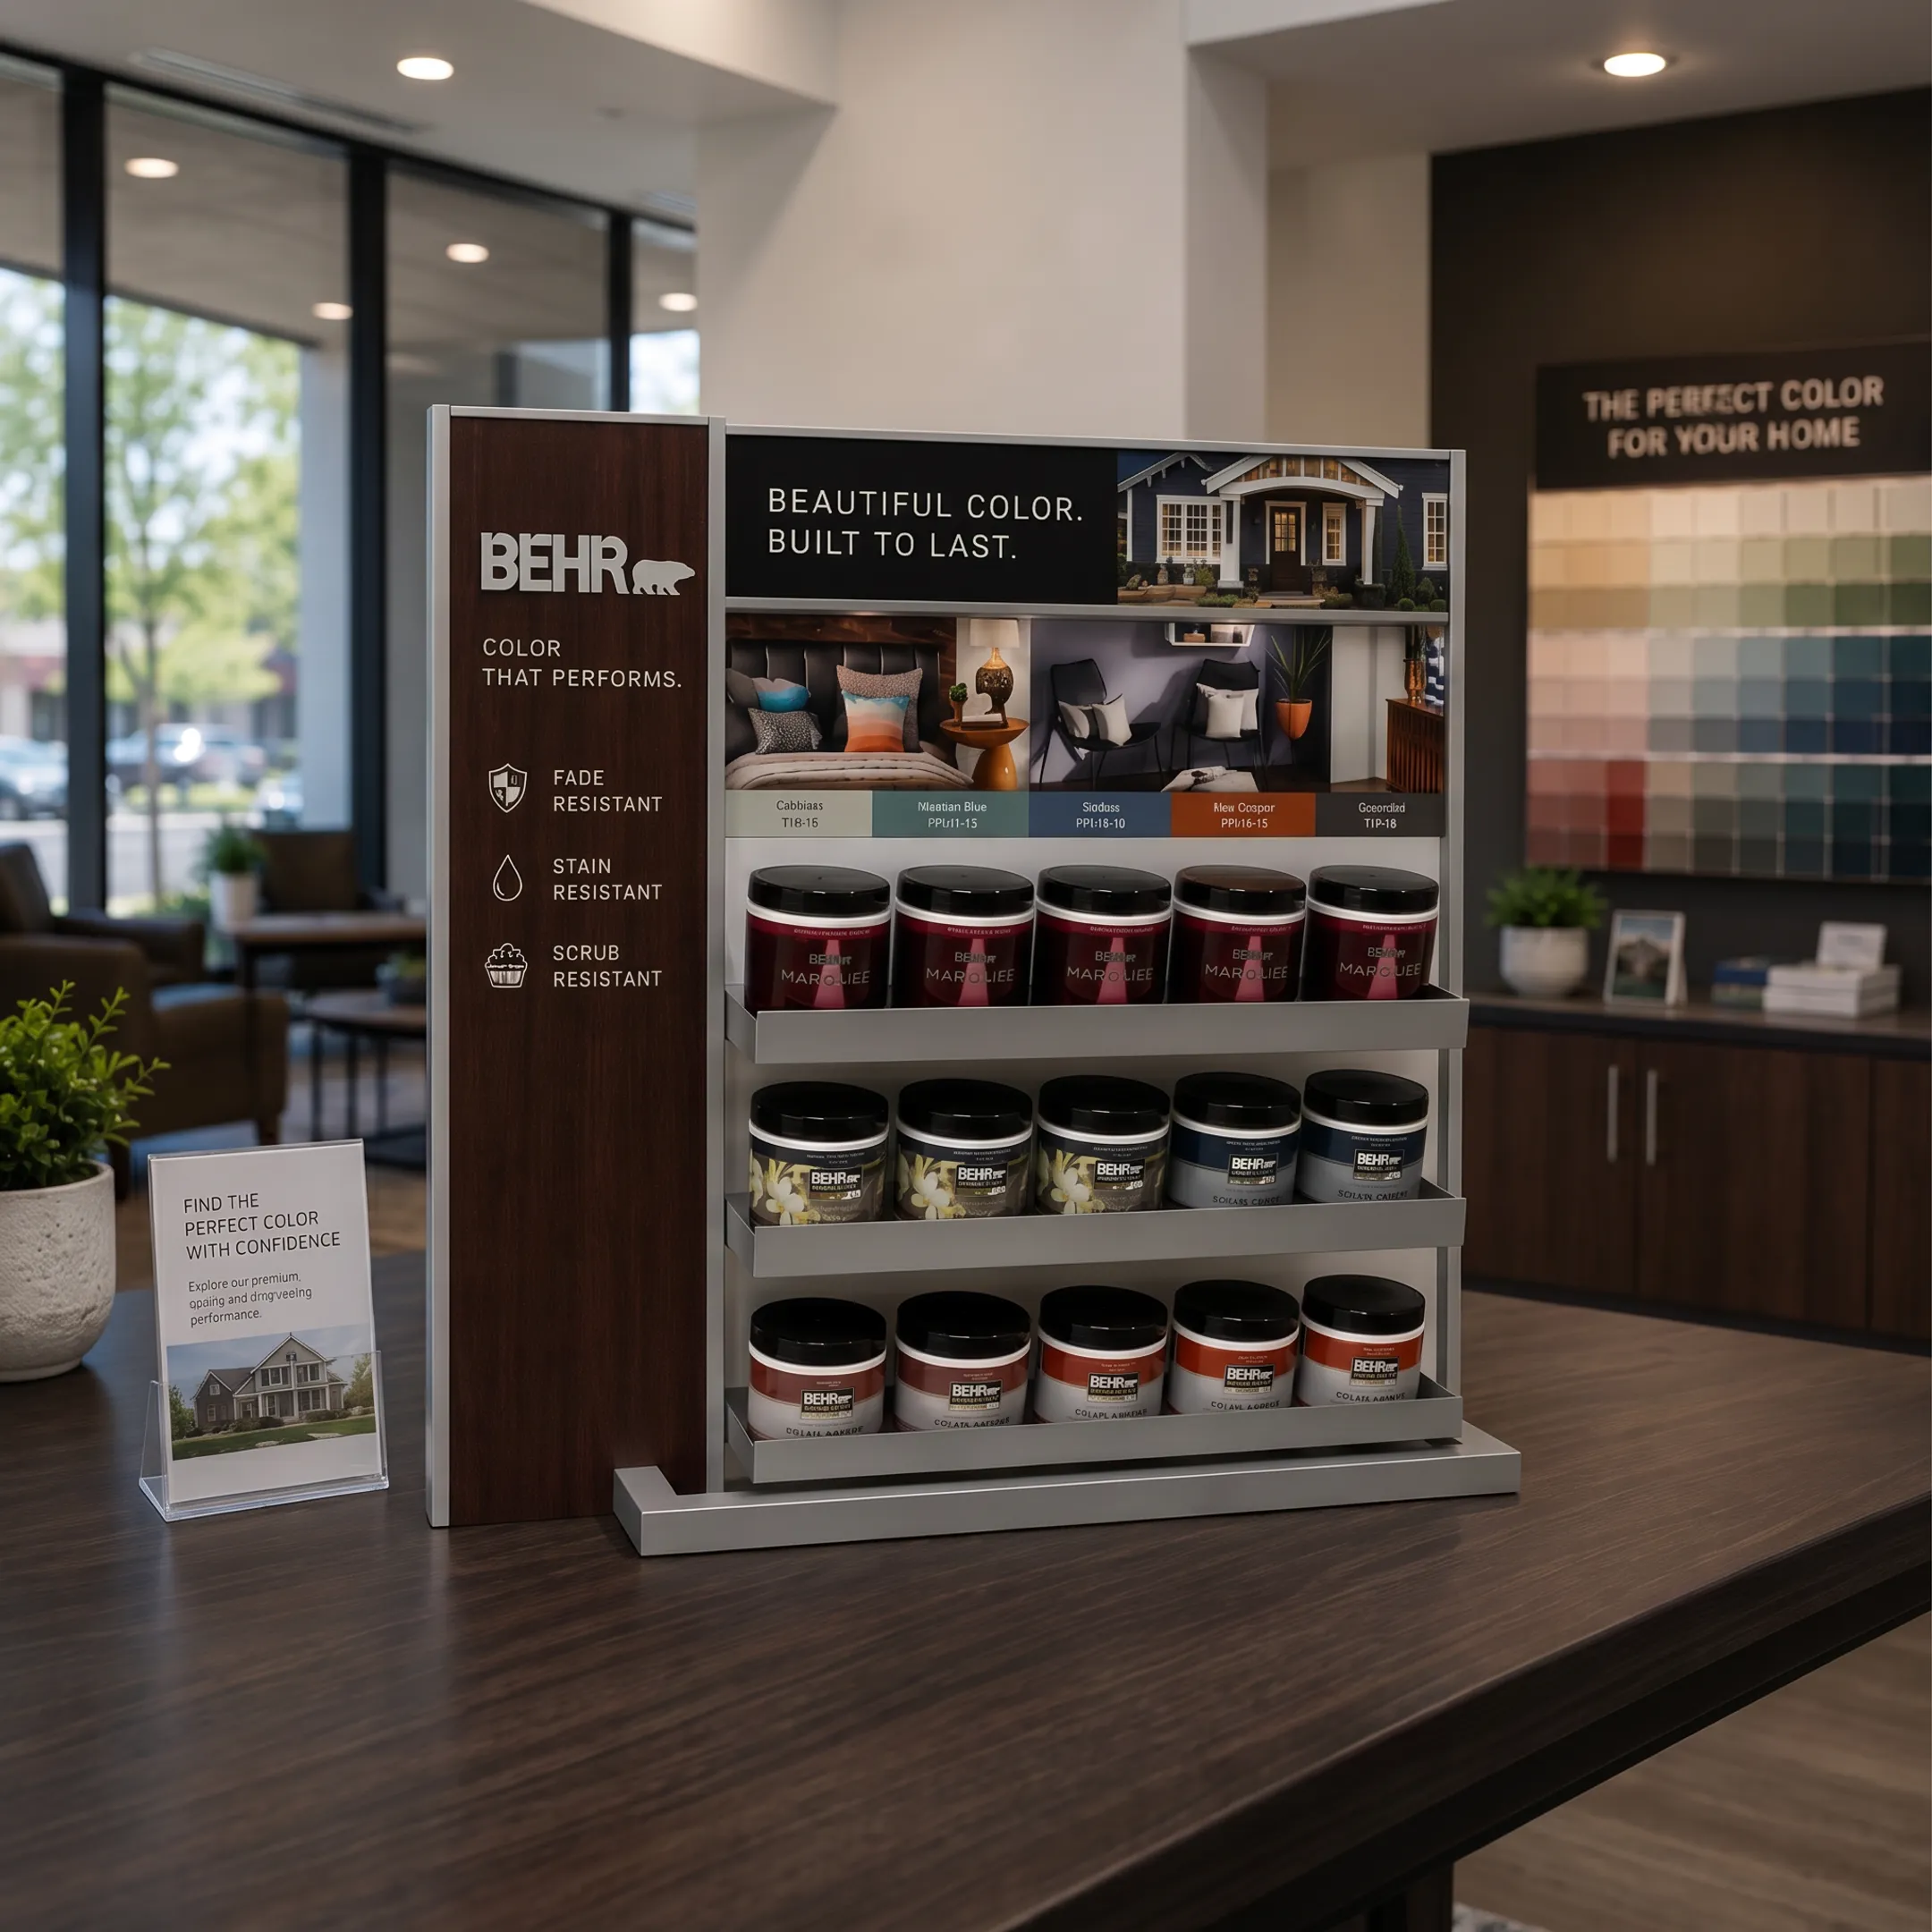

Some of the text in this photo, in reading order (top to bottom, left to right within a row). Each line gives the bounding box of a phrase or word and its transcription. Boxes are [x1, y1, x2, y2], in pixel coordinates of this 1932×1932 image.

[1583, 388, 1640, 422] THE
[1781, 376, 1884, 411] COLOR
[1608, 416, 1860, 459] FOR YOUR HOME
[768, 487, 1083, 521] BEAUTIFUL COLOR.
[768, 529, 1017, 559] BUILT TO LAST.
[480, 532, 630, 595] BEHR
[483, 639, 562, 657] COLOR
[482, 668, 682, 689] THAT PERFORMS.
[553, 769, 605, 787] FADE
[553, 796, 663, 812] RESISTANT
[963, 801, 987, 812] Blue
[553, 858, 611, 875] STAIN
[553, 884, 663, 901] RESISTANT
[553, 945, 620, 962] SCRUB
[553, 970, 663, 987] RESISTANT
[1232, 1157, 1265, 1170] BEHR
[1358, 1152, 1389, 1165] BEHR
[811, 1172, 846, 1184] BEHR
[958, 1166, 993, 1180] BEHR
[1097, 1163, 1131, 1176] BEHR
[183, 1193, 259, 1214] FIND THE
[184, 1210, 318, 1236] PERFECT COLOR
[186, 1231, 341, 1260] WITH CONFIDENCE
[189, 1279, 229, 1293] Explore
[231, 1278, 249, 1288] our
[228, 1292, 248, 1304] and
[190, 1309, 262, 1327] performance.
[1227, 1368, 1261, 1381] BEHR
[1354, 1360, 1386, 1372] BEHR
[952, 1384, 987, 1397] BEHR
[1089, 1376, 1124, 1388] BEHR
[803, 1393, 839, 1406] BEHR
